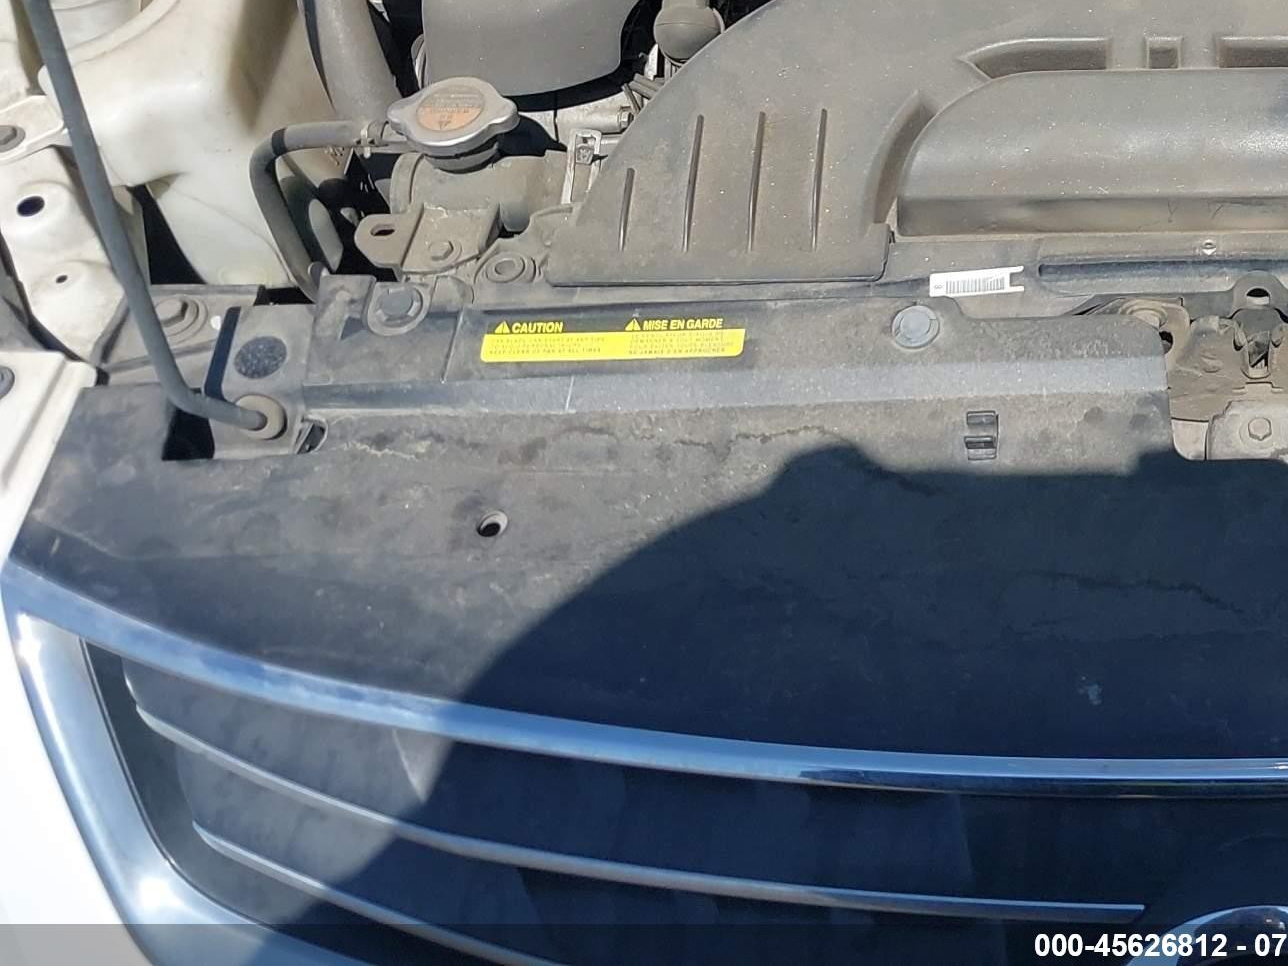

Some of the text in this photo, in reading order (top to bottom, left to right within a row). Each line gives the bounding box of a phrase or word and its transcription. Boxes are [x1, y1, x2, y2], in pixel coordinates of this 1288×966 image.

[512, 321, 564, 333] CAUTION
[643, 318, 723, 331] MISE EN GARDE
